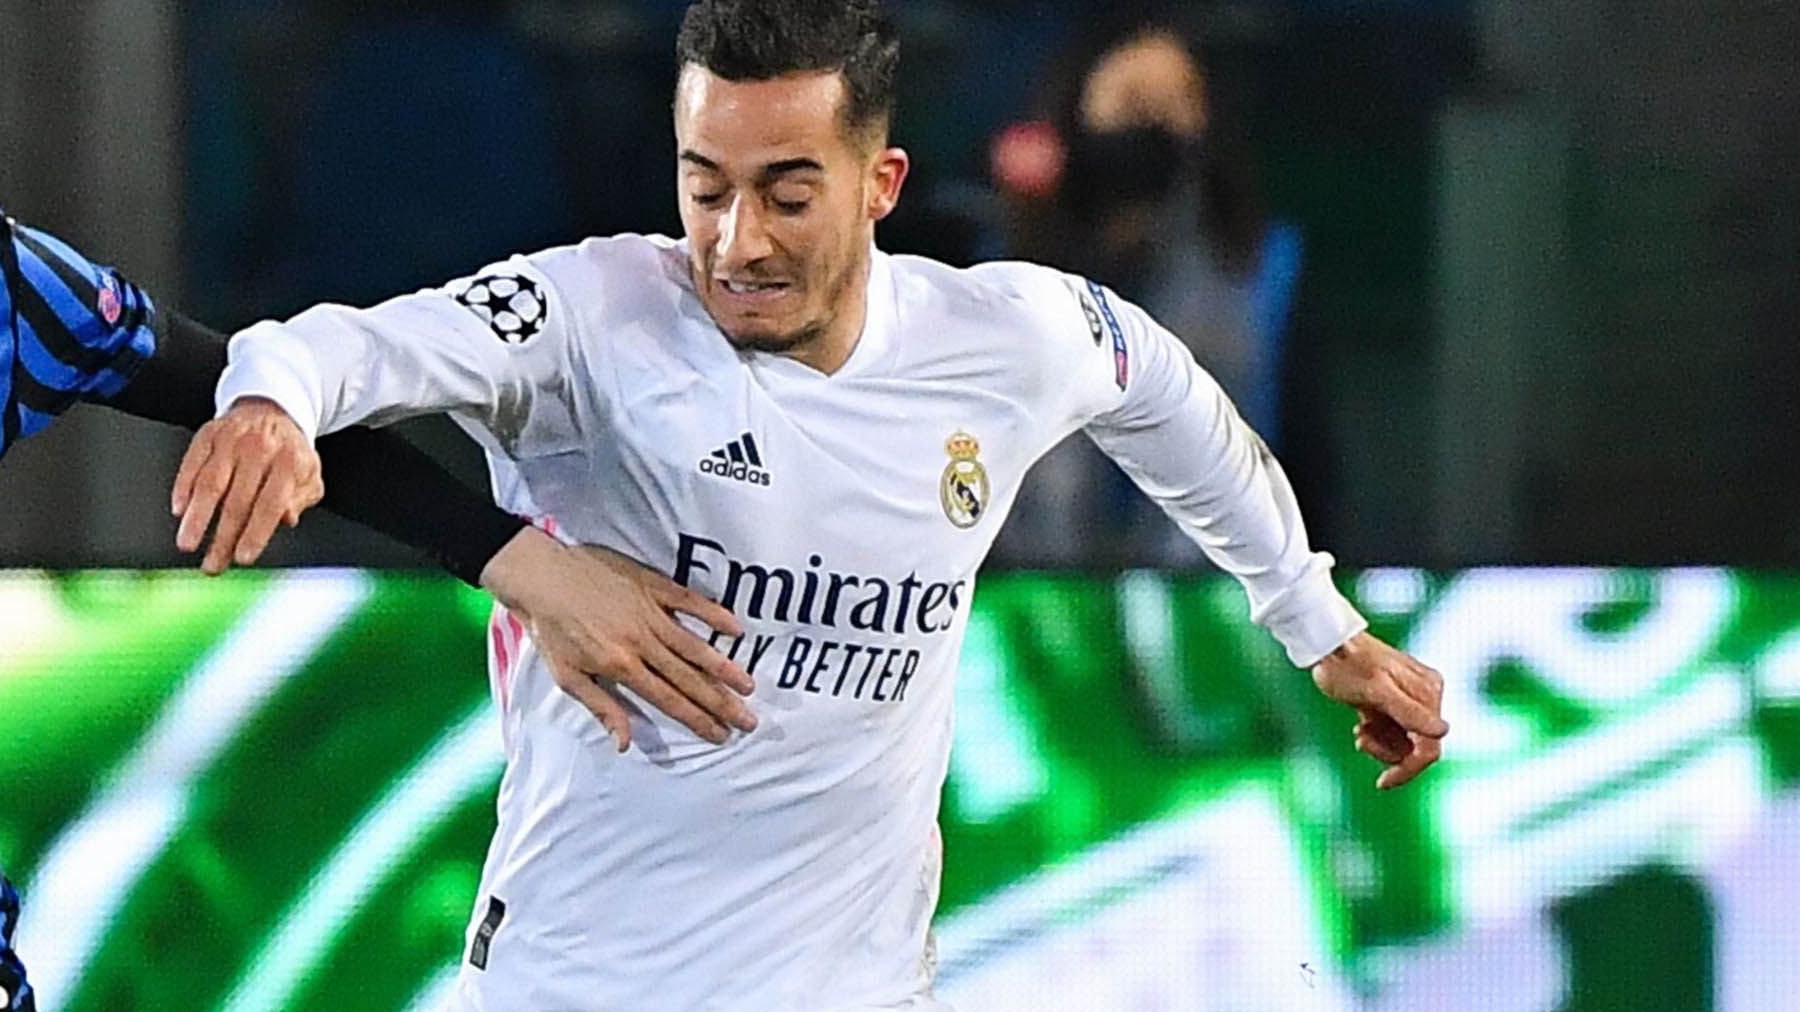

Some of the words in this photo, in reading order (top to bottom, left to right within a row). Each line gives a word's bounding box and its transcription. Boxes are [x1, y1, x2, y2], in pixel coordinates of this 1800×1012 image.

[700, 459, 771, 486] adidas
[673, 532, 966, 634] Emirates
[776, 635, 921, 702] BETTER
